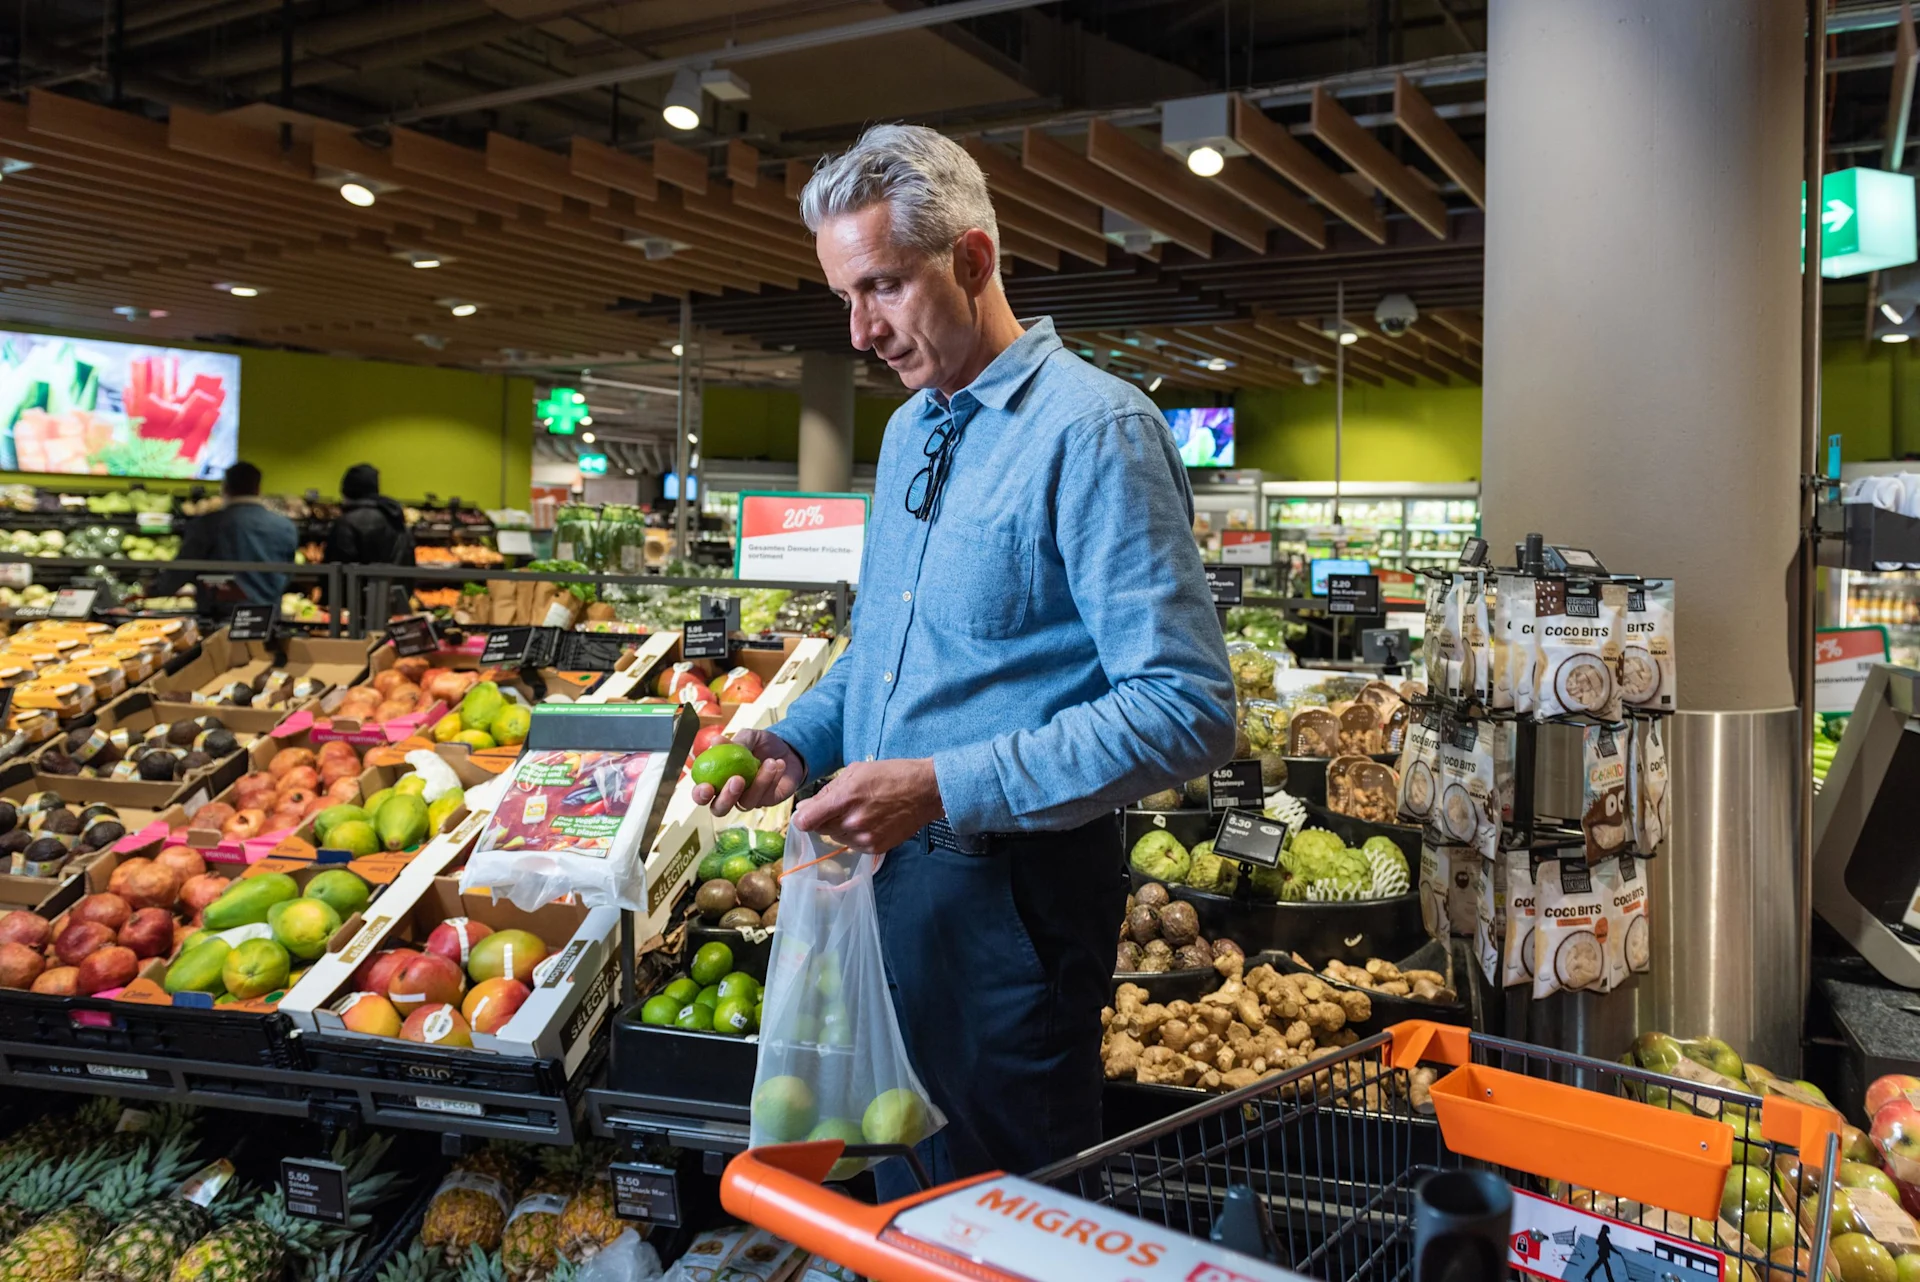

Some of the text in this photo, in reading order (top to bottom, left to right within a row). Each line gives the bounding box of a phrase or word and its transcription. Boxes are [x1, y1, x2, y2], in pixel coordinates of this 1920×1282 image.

[782, 504, 825, 529] 20%
[748, 544, 786, 552] Gesamtes
[787, 545, 820, 553] Demeter
[1331, 580, 1351, 588] 2.20
[1545, 626, 1579, 637] COCO
[1582, 627, 1609, 637] BITS
[1627, 622, 1655, 633] BITS
[1411, 733, 1440, 750] OCO BITS
[1460, 759, 1477, 773] BITS
[1212, 769, 1234, 779] 4.50
[1225, 825, 1250, 837] Ingwer
[654, 846, 695, 906] SÉLECTION
[1614, 886, 1645, 907] COCO BITS
[1544, 904, 1602, 918] COCO BITS
[570, 960, 621, 1040] SÉLECTION
[288, 1171, 310, 1182] 5.50
[616, 1175, 640, 1187] 3.50
[629, 1186, 651, 1195] Snack
[976, 1187, 1168, 1268] MIGROS
